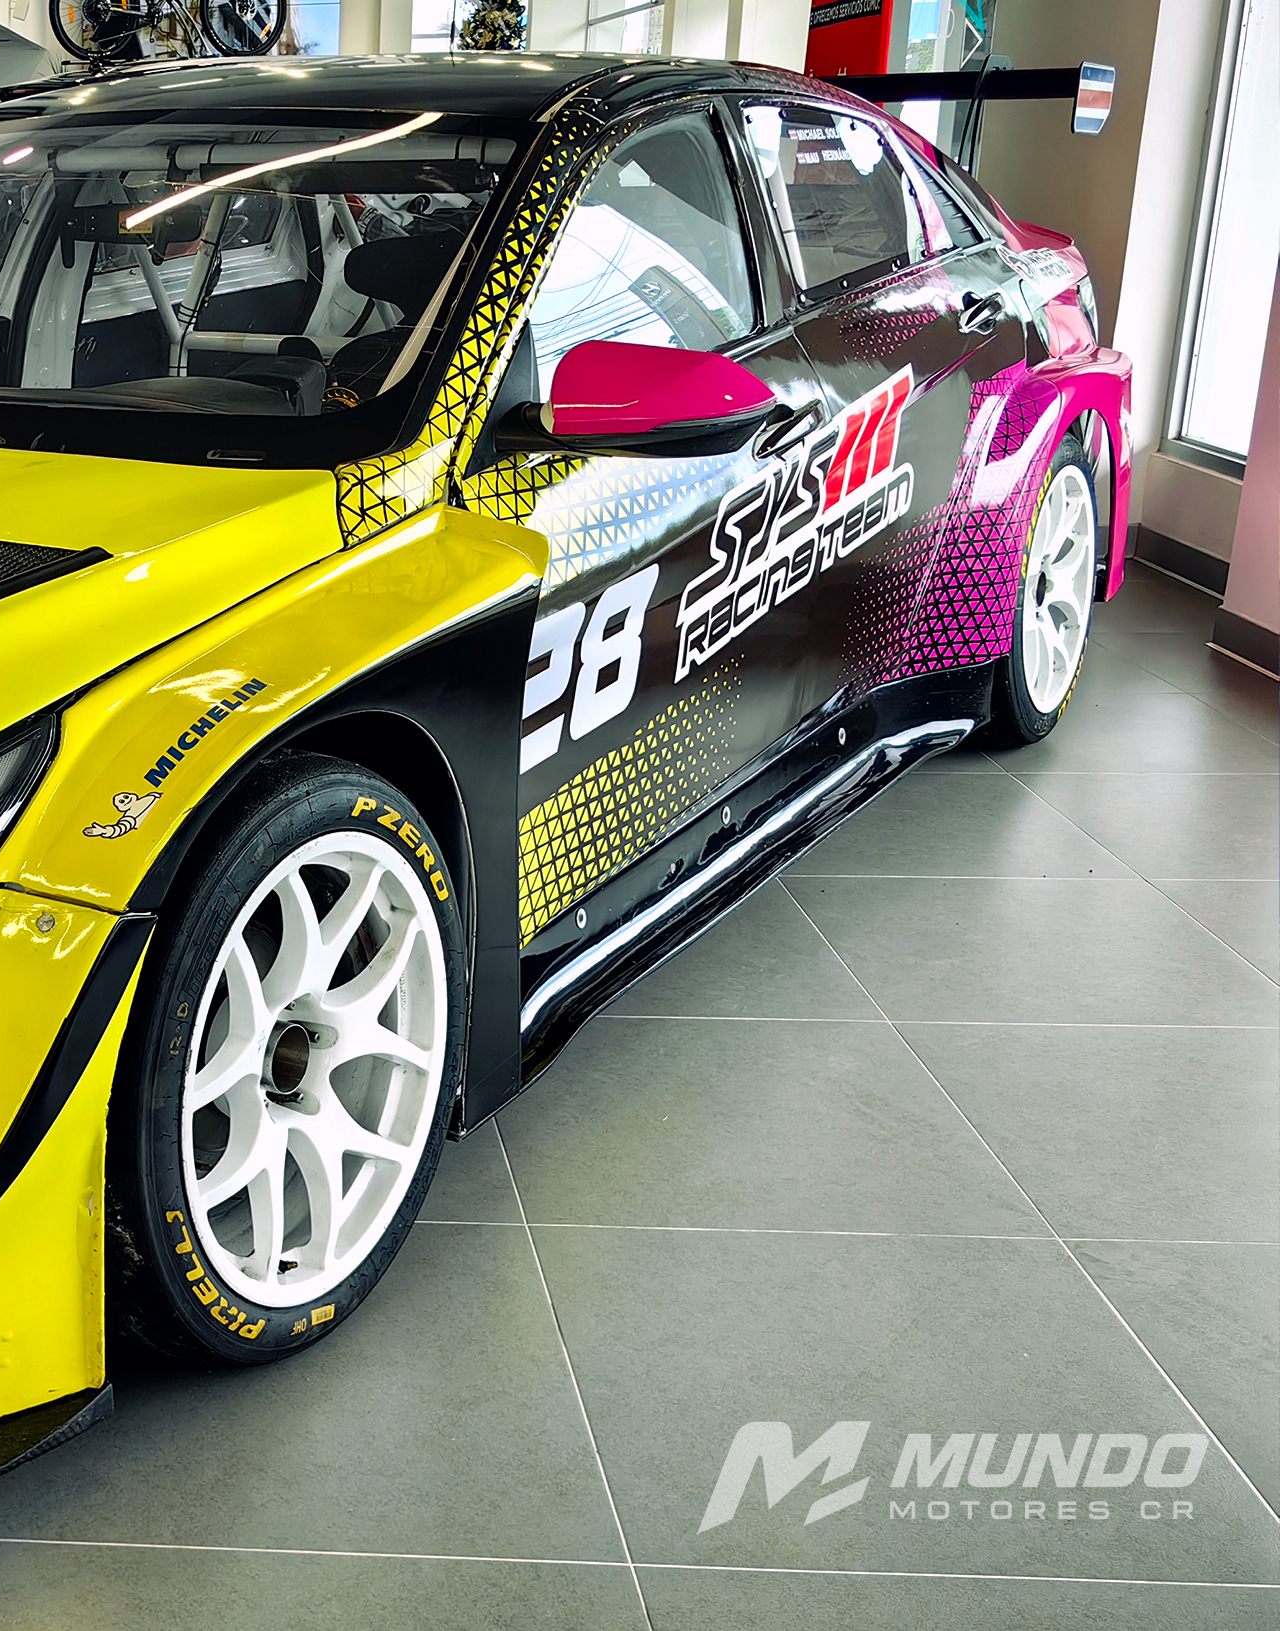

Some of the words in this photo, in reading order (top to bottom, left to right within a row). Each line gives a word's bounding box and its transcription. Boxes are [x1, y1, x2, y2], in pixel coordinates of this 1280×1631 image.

[796, 128, 826, 141] MICHAEL
[520, 563, 660, 775] 28
[144, 678, 267, 788] MICHELIN
[165, 1210, 267, 1340] PIRELLI
